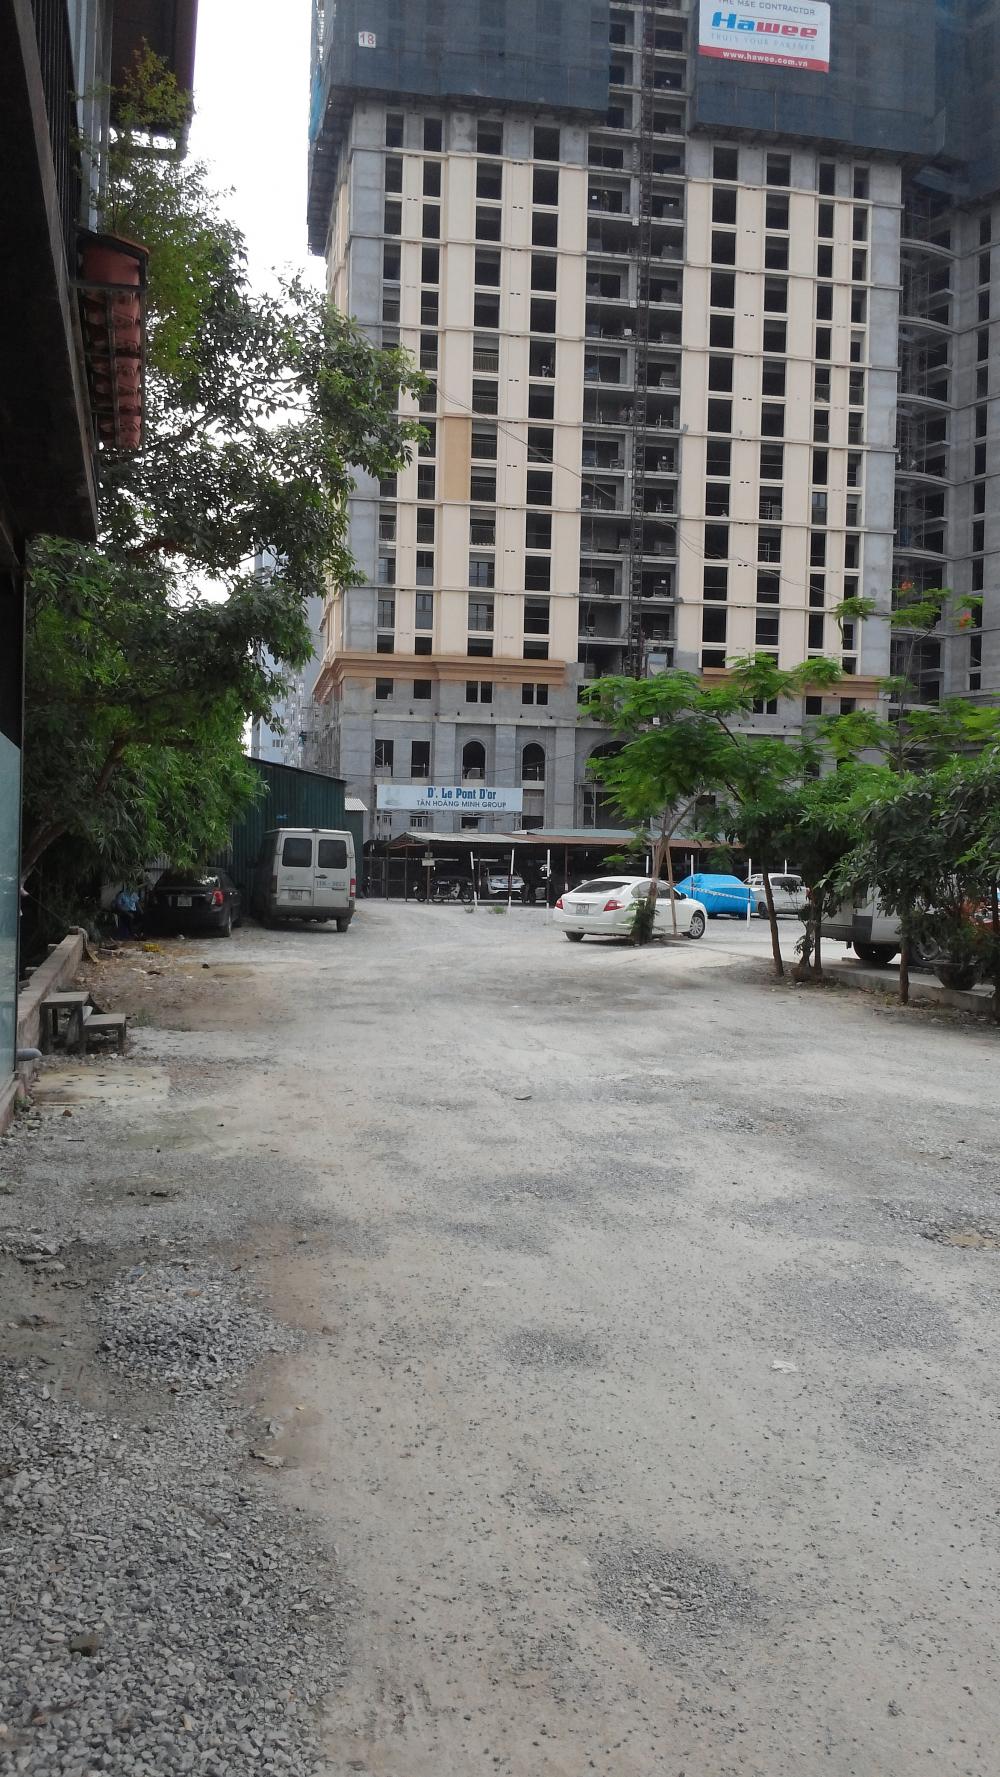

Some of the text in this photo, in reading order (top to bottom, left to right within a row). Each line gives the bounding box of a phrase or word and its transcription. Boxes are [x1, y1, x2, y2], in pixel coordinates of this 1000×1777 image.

[759, 2, 816, 16] CONTRACTOR
[711, 11, 818, 38] Hawee
[360, 33, 374, 45] 18
[441, 787, 453, 799] Le
[455, 787, 477, 800] Pont
[479, 788, 497, 800] D'or
[461, 800, 481, 808] MINH
[481, 801, 507, 809] GROUP
